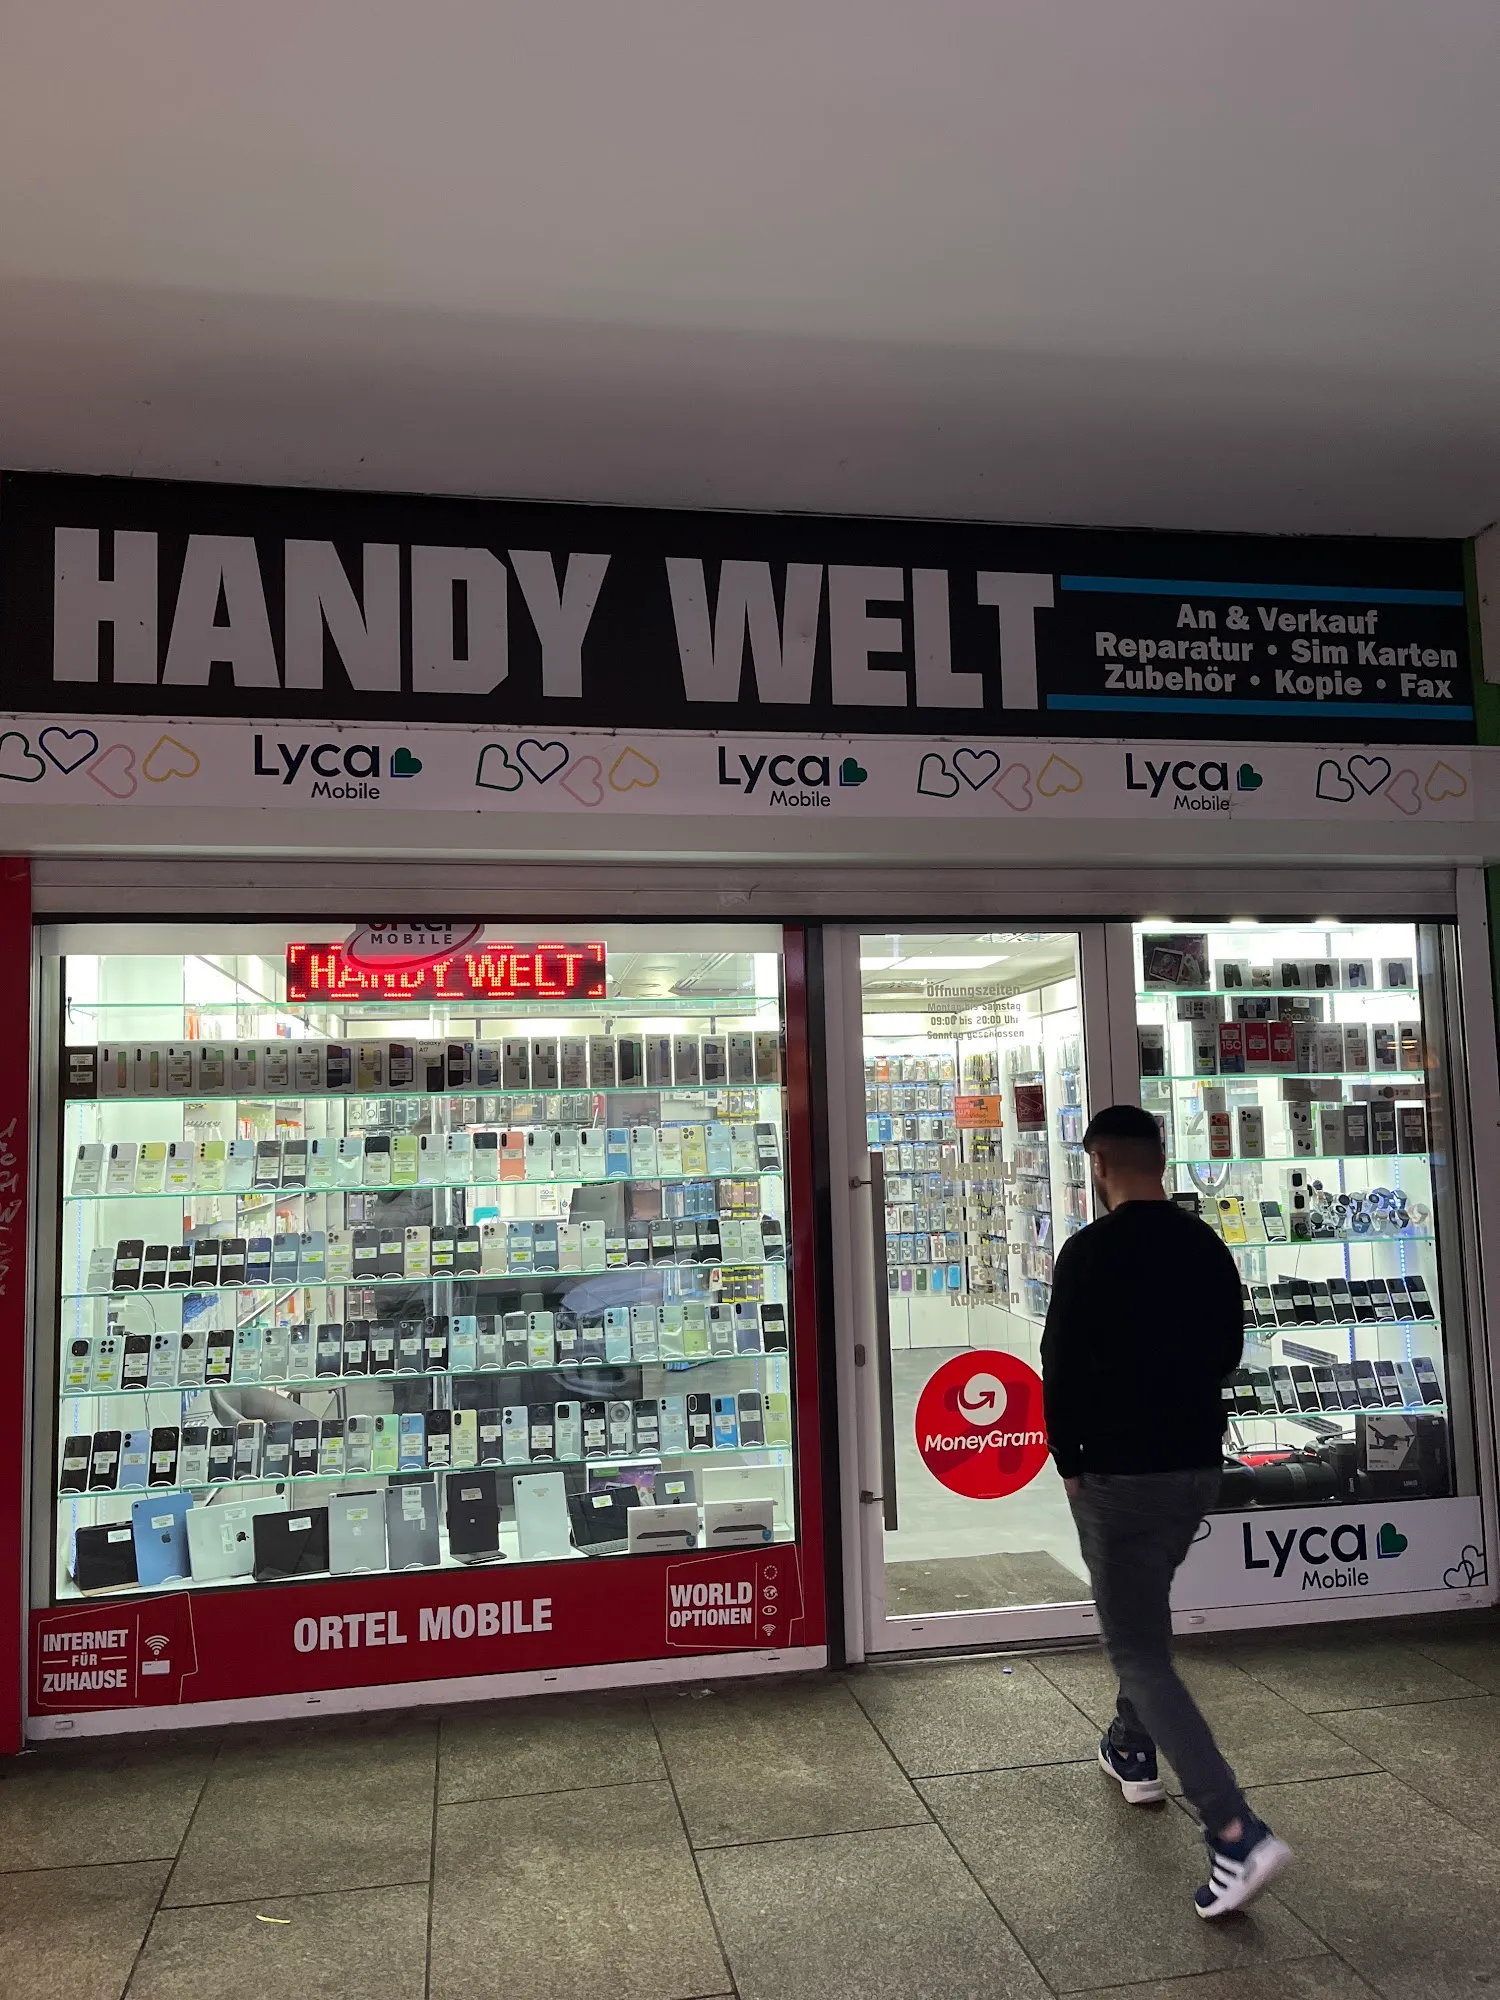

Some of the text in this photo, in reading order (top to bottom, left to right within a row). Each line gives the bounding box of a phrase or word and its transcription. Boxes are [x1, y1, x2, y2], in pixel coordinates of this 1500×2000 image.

[53, 527, 1055, 710] HANDY WELT
[1176, 604, 1379, 635] An & Verkauf
[1095, 631, 1459, 669] Reparatur Sim Karten
[1104, 663, 1453, 700] Zubehör Kopie Fax
[253, 734, 381, 786] Lyca
[718, 745, 831, 794] Lyca
[1126, 752, 1231, 799] Lyca
[310, 780, 381, 801] Mobile
[769, 788, 831, 808] Mobile
[1173, 793, 1231, 812] Mobile
[371, 933, 453, 945] MOBILE
[465, 953, 584, 988] WELT
[926, 981, 1021, 998] Öffnungszeiten
[927, 1002, 964, 1014] Montag
[981, 1002, 1022, 1012] Samstag
[930, 1016, 957, 1027] 09:00
[959, 1016, 973, 1025] bis
[976, 1015, 1002, 1025] 20:00
[927, 1029, 1025, 1041] Sonntag geschlossen
[941, 1154, 1017, 1185] Handy
[934, 1243, 1030, 1258] Reparaturen
[950, 1291, 1020, 1310] Kopieren
[924, 1429, 1044, 1454] MoneyGram
[1241, 1521, 1368, 1578] Lyca
[1301, 1567, 1369, 1590] Mobile
[669, 1582, 753, 1608] WORLD
[293, 1597, 553, 1654] ORTEL MOBILE
[669, 1607, 752, 1628] OPTIONEN
[42, 1629, 129, 1653] INTERNET
[71, 1651, 98, 1667] FÜR
[42, 1668, 128, 1693] ZUHAUSE
